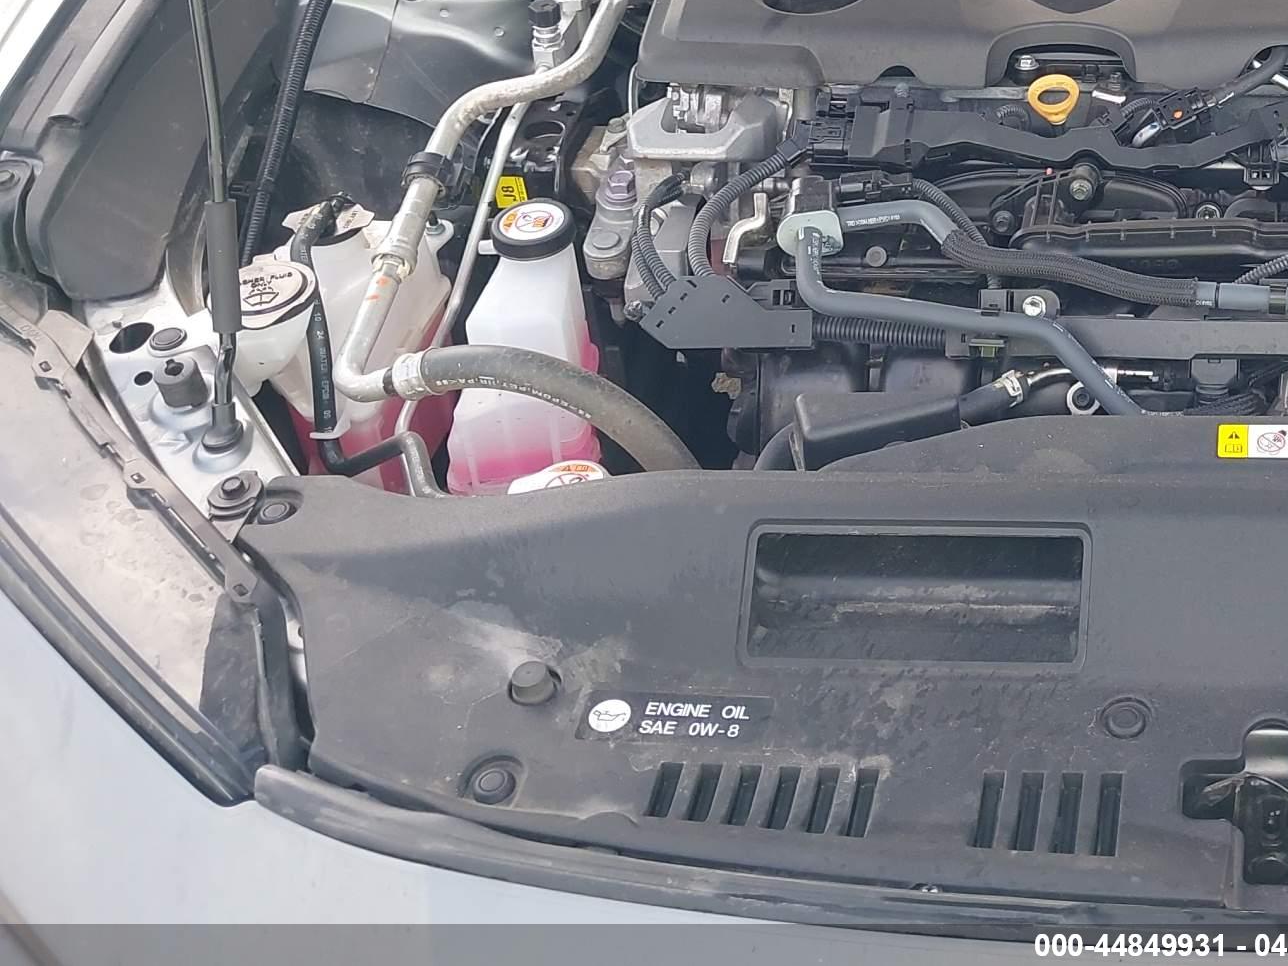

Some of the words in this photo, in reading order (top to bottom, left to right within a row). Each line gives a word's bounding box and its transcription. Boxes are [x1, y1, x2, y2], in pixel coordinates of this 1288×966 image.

[644, 701, 712, 718] ENGINE
[721, 705, 750, 720] OIL
[638, 720, 678, 735] SAE
[688, 722, 740, 738] 0W-8
